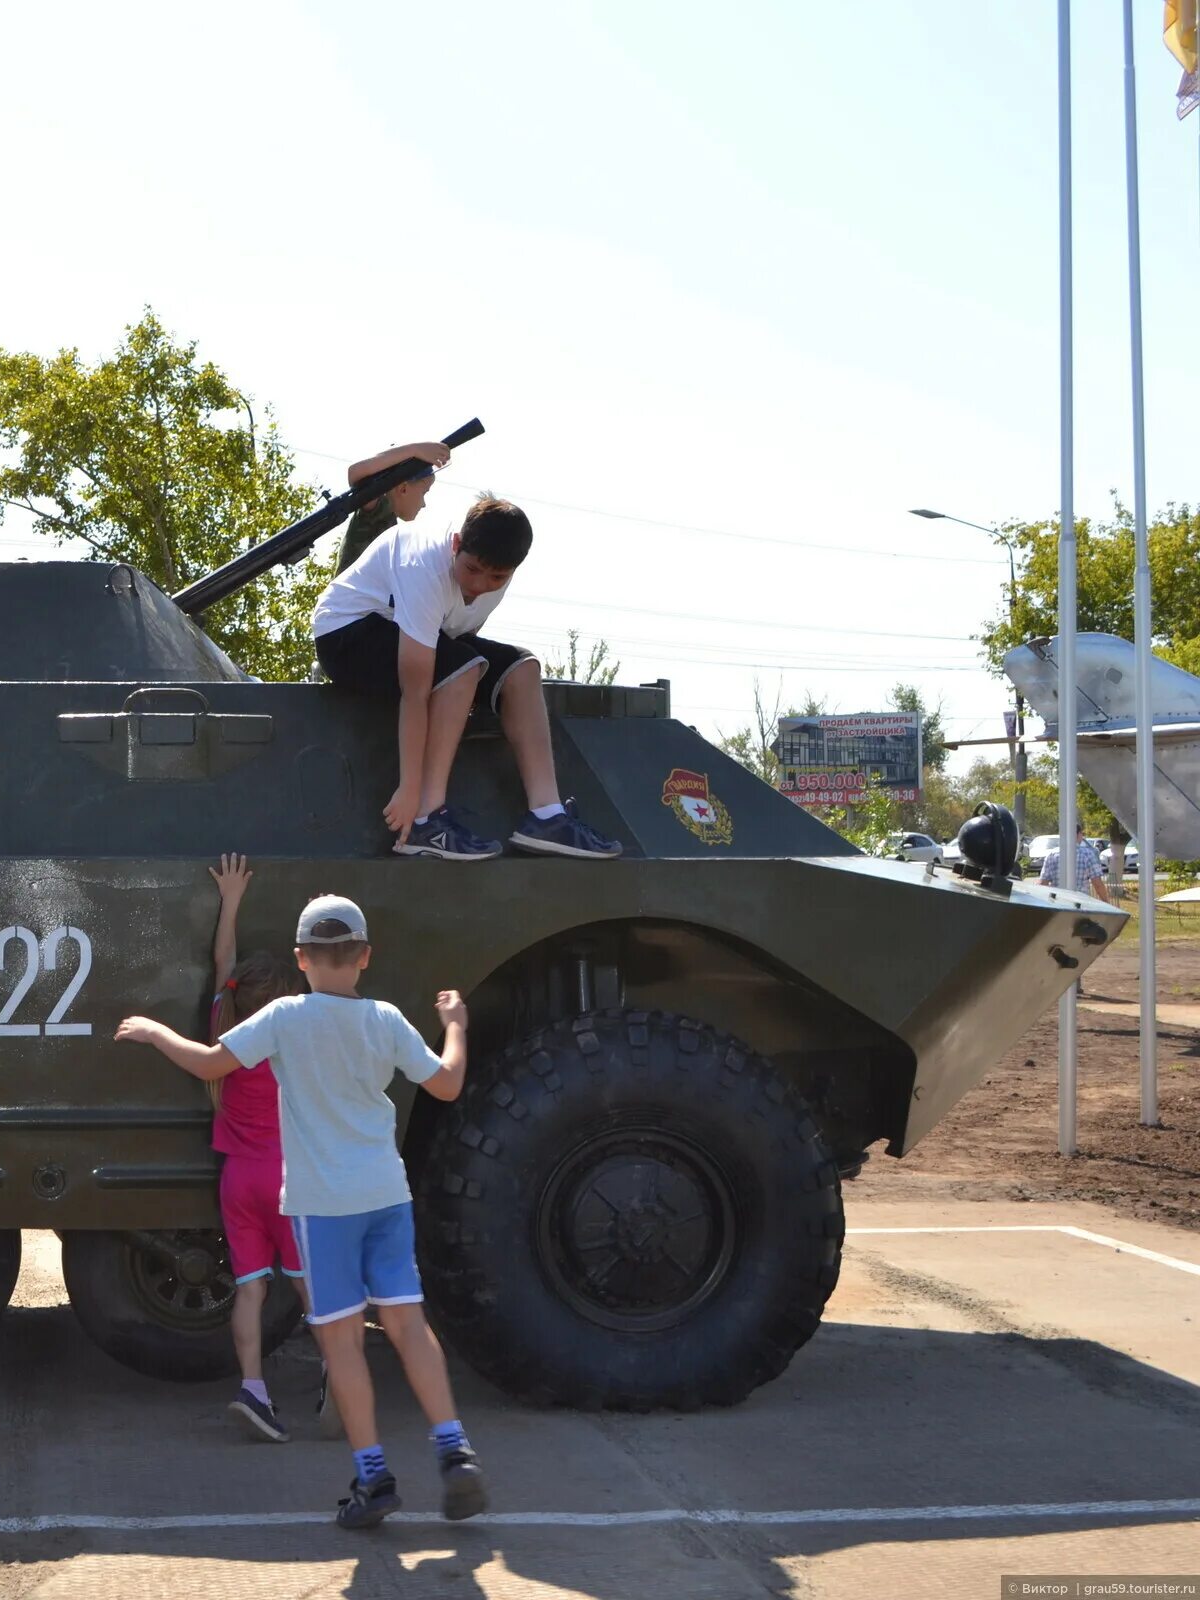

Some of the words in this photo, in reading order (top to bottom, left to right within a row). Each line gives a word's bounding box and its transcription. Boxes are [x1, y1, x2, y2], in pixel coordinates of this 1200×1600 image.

[819, 718, 861, 728] ПРОДАЁМ
[864, 716, 913, 726] КВАРТИРЫ
[838, 727, 906, 737] ЗАСТРОЙЩИКА
[798, 773, 866, 790] 950.000
